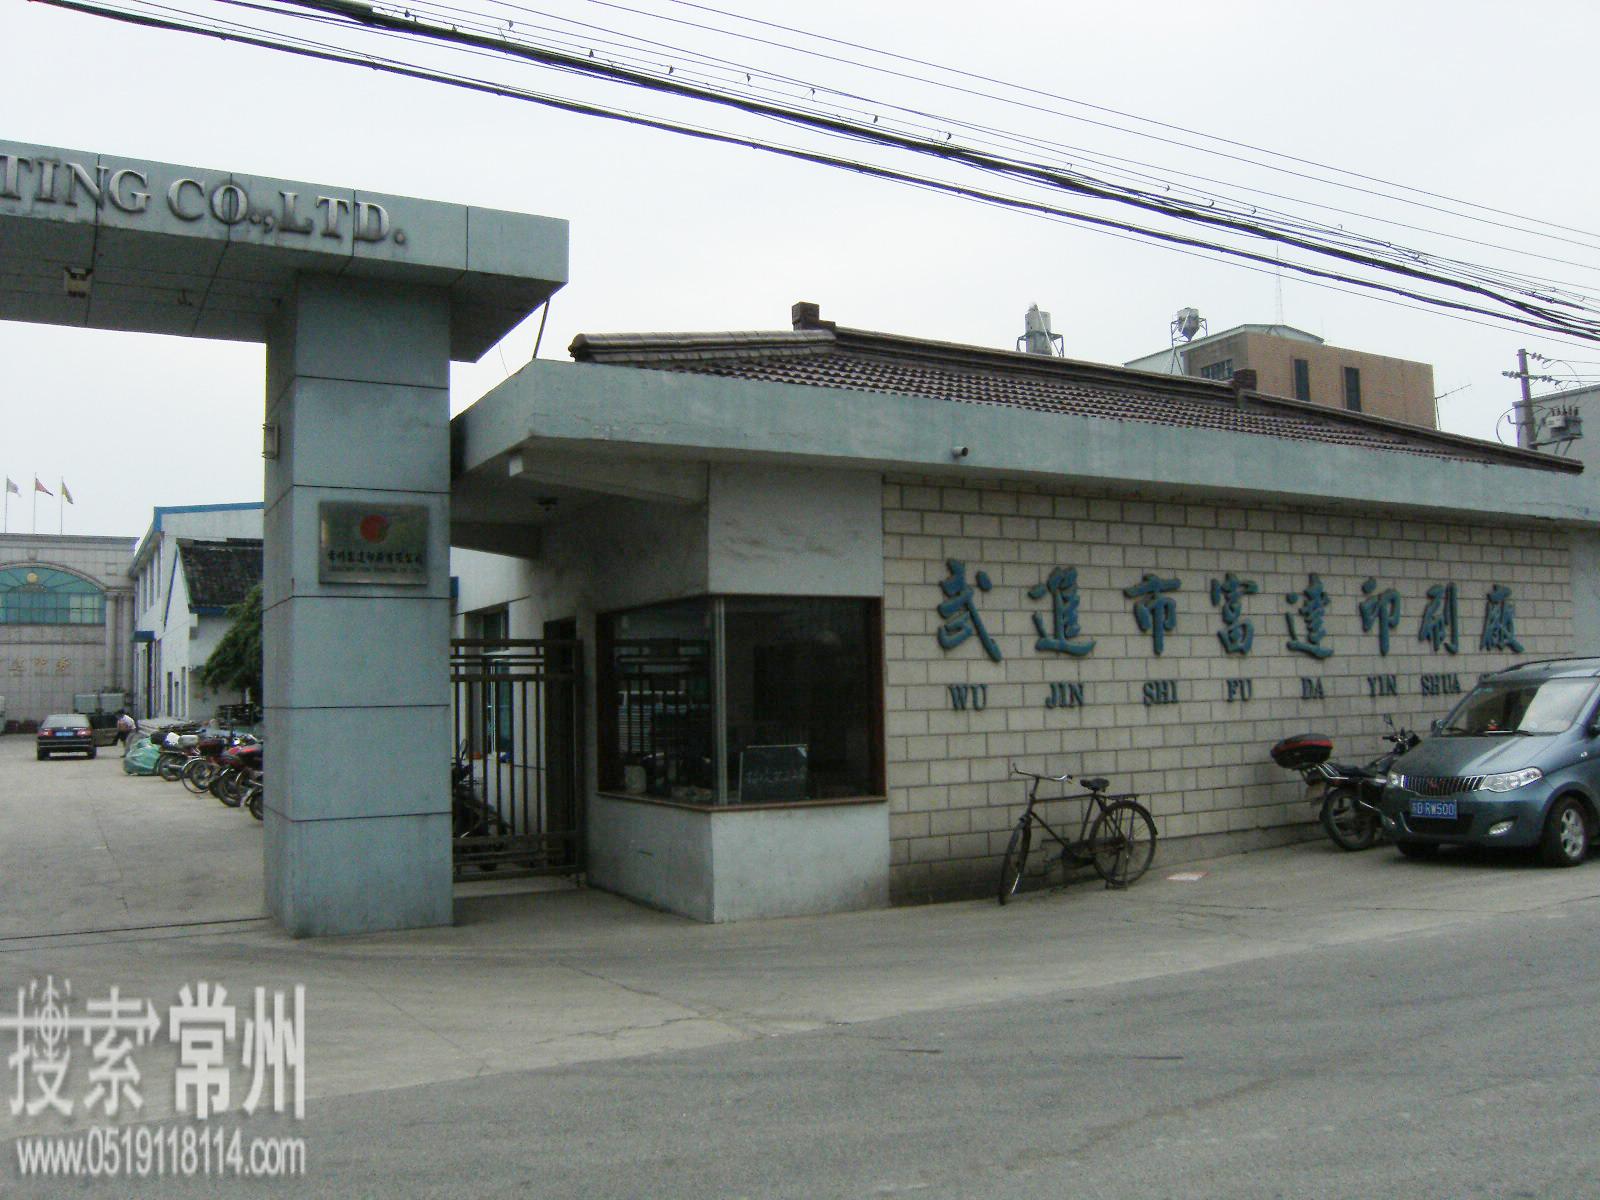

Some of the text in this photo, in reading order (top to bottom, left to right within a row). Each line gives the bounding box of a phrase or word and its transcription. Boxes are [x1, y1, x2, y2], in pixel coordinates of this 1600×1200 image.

[948, 683, 987, 711] WU
[1045, 681, 1084, 709] JIN
[1143, 678, 1178, 706] SHI
[1226, 678, 1253, 703] FU
[1301, 676, 1325, 700] DA
[1367, 673, 1398, 697] YIN
[1420, 671, 1462, 697] SHUA
